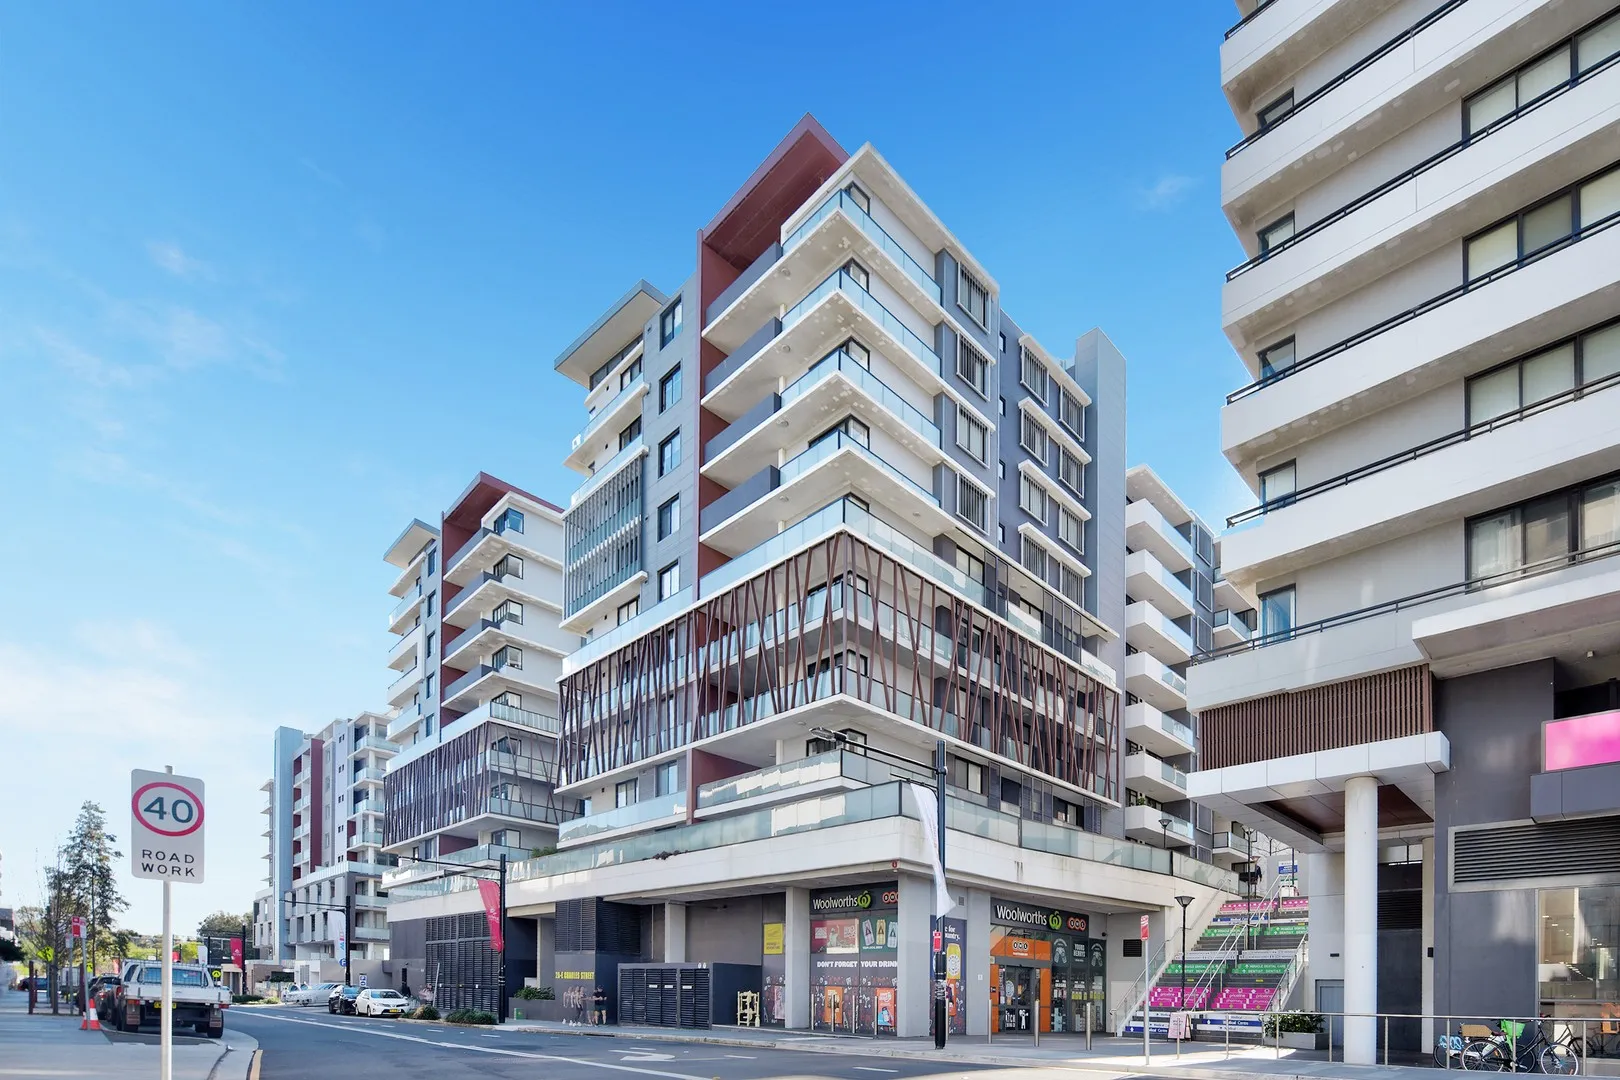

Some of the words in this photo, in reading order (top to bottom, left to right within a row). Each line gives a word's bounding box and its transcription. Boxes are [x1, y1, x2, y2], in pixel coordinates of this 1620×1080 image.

[143, 796, 194, 824] 40
[141, 849, 195, 864] ROAD
[141, 862, 195, 877] WORK
[813, 894, 858, 910] Woolworths
[996, 904, 1048, 926] Woolworths
[816, 960, 834, 968] DON'T
[834, 960, 858, 968] FORGET
[860, 960, 878, 968] YOUR
